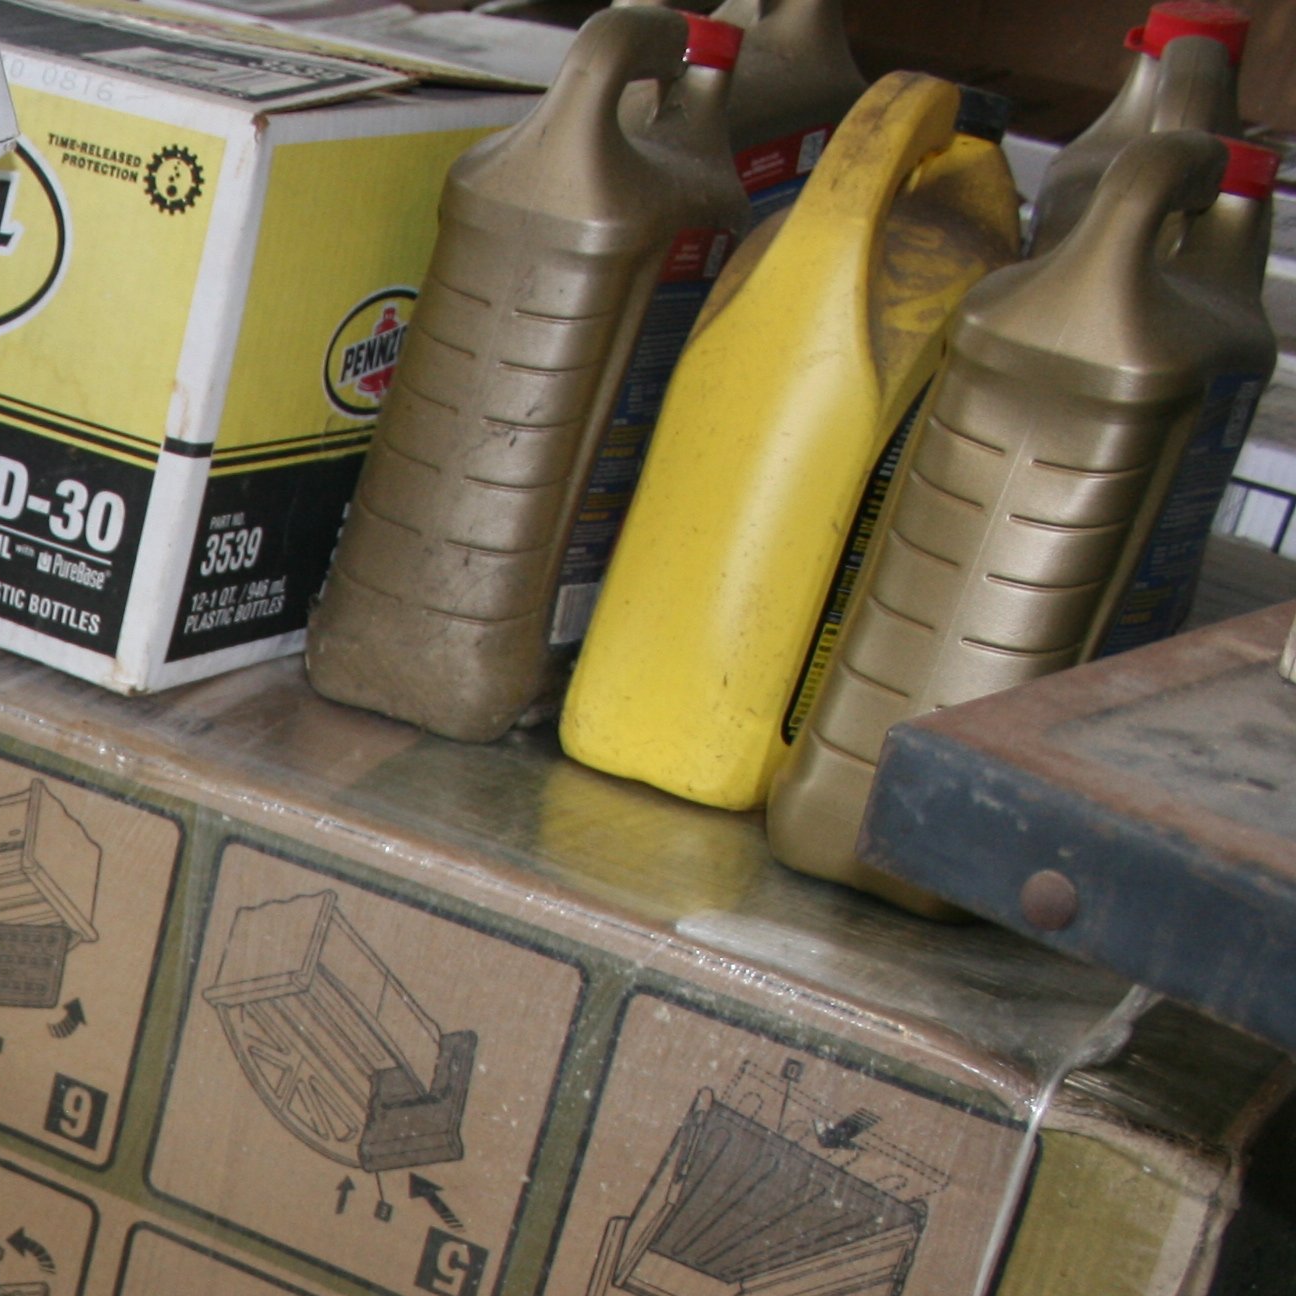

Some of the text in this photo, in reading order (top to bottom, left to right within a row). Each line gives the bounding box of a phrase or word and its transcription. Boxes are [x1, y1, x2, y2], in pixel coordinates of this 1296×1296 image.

[48, 132, 143, 168] TIME-RELEASED
[61, 152, 139, 183] PROTECTION
[340, 326, 408, 384] PENNZ
[51, 553, 105, 590] PureBase
[200, 527, 263, 577] 3539
[28, 593, 101, 635] BOTTLES
[184, 595, 284, 634] PLASTIC BOTTLES
[63, 1086, 97, 1135] 6
[434, 1240, 472, 1291] 5
